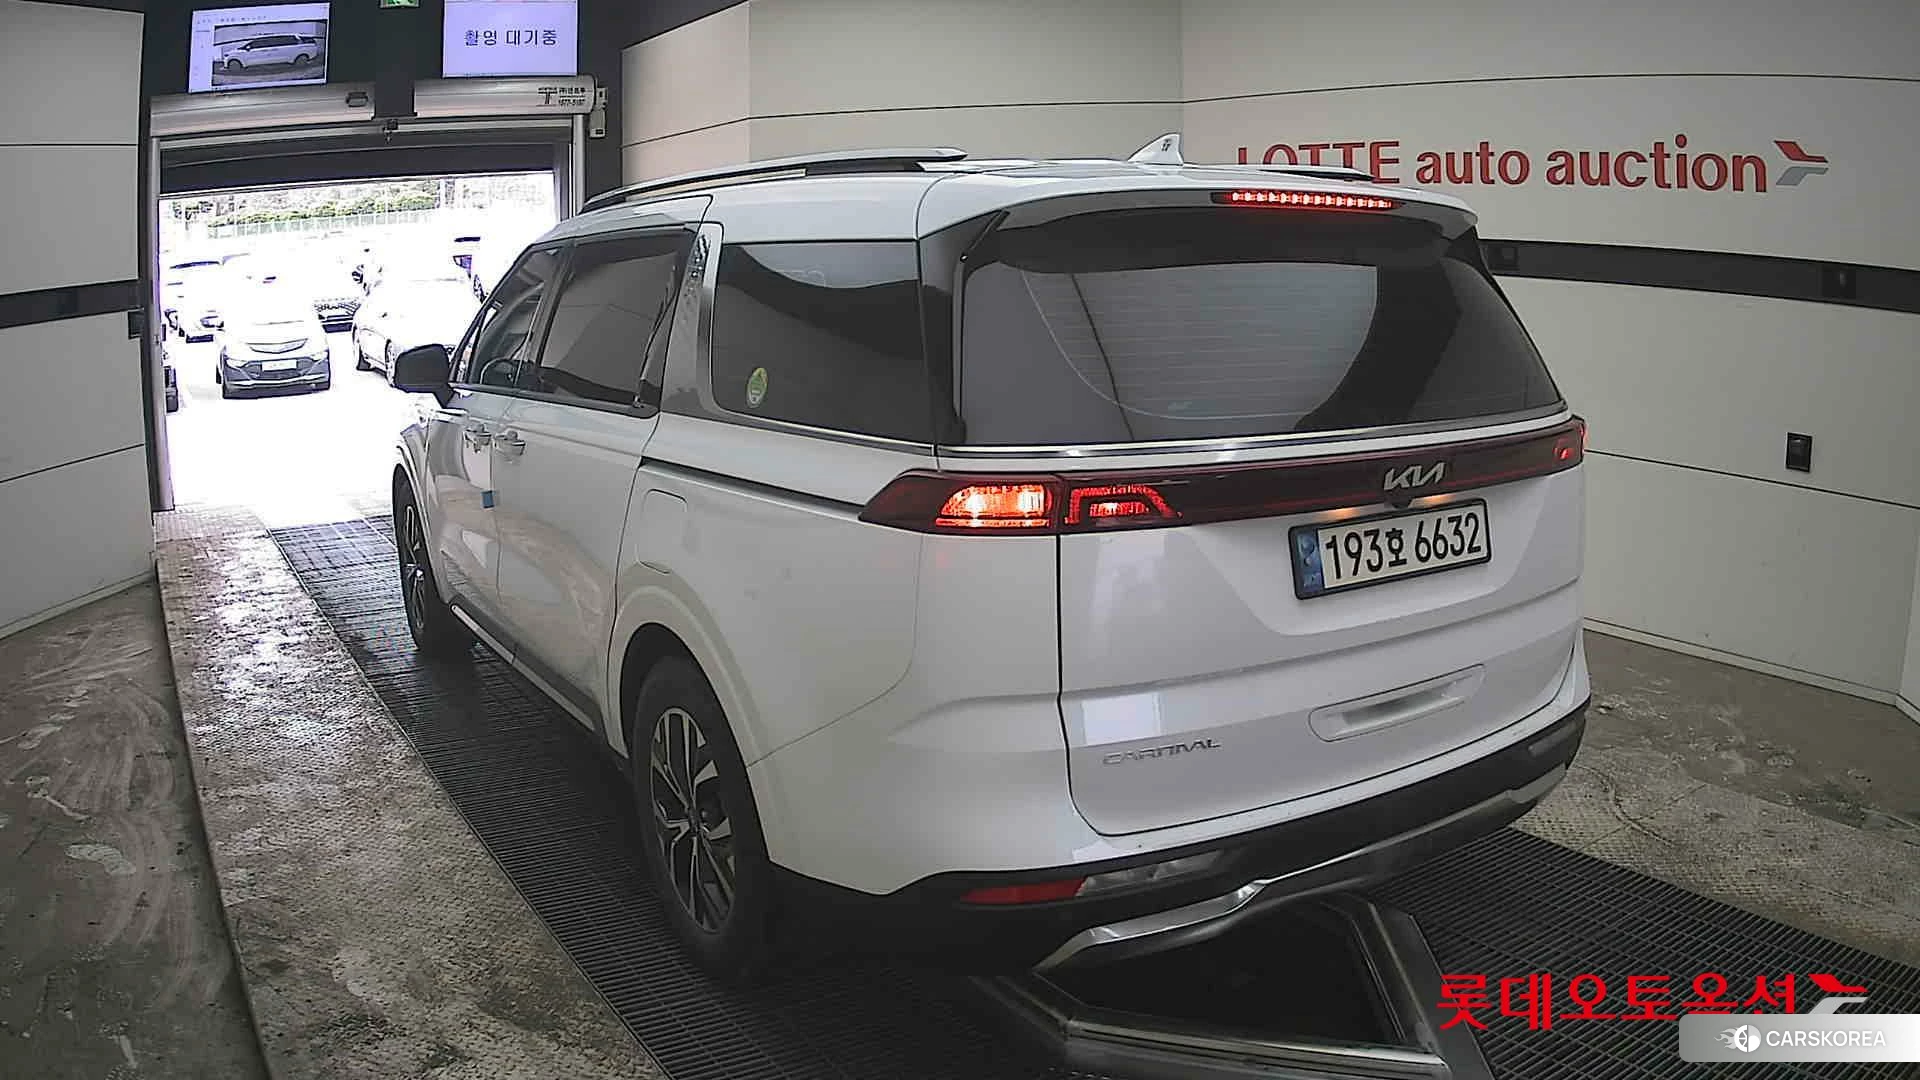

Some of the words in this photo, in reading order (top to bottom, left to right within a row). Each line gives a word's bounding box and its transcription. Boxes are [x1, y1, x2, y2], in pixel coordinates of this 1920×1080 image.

[505, 29, 557, 46] 대기중
[1415, 141, 1531, 185] auto
[1546, 134, 1768, 193] auction
[1383, 462, 1446, 491] KIA
[1325, 528, 1408, 579] 193호
[1415, 512, 1482, 563] 6632
